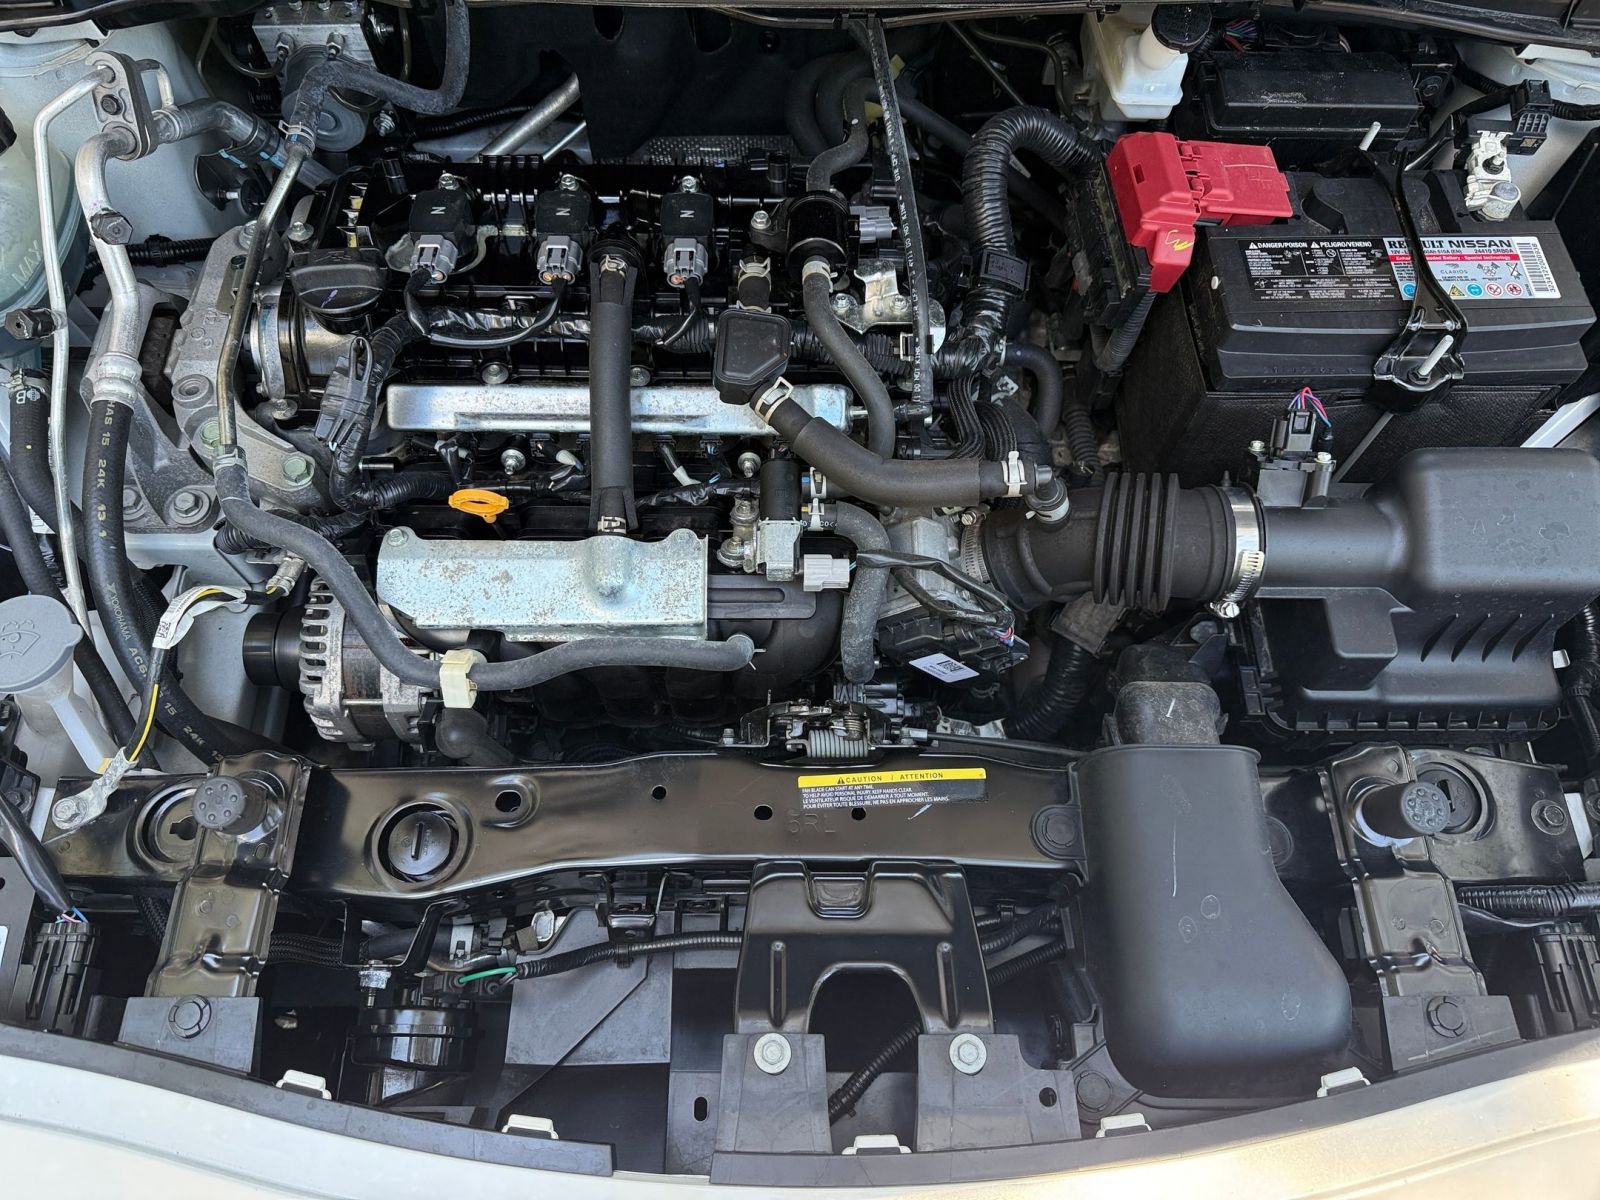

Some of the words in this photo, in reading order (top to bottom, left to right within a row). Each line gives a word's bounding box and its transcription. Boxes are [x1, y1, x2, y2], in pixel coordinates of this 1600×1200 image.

[1388, 240, 1444, 249] REULT
[1448, 239, 1512, 249] NISSAN
[11, 240, 41, 286] MAX
[914, 384, 920, 393] DO
[101, 432, 110, 446] 15
[96, 459, 106, 488] 24K
[111, 594, 132, 641] YOKOHAMA
[163, 702, 177, 716] 15
[845, 776, 882, 784] CAUTION
[900, 772, 944, 780] ATTENTION
